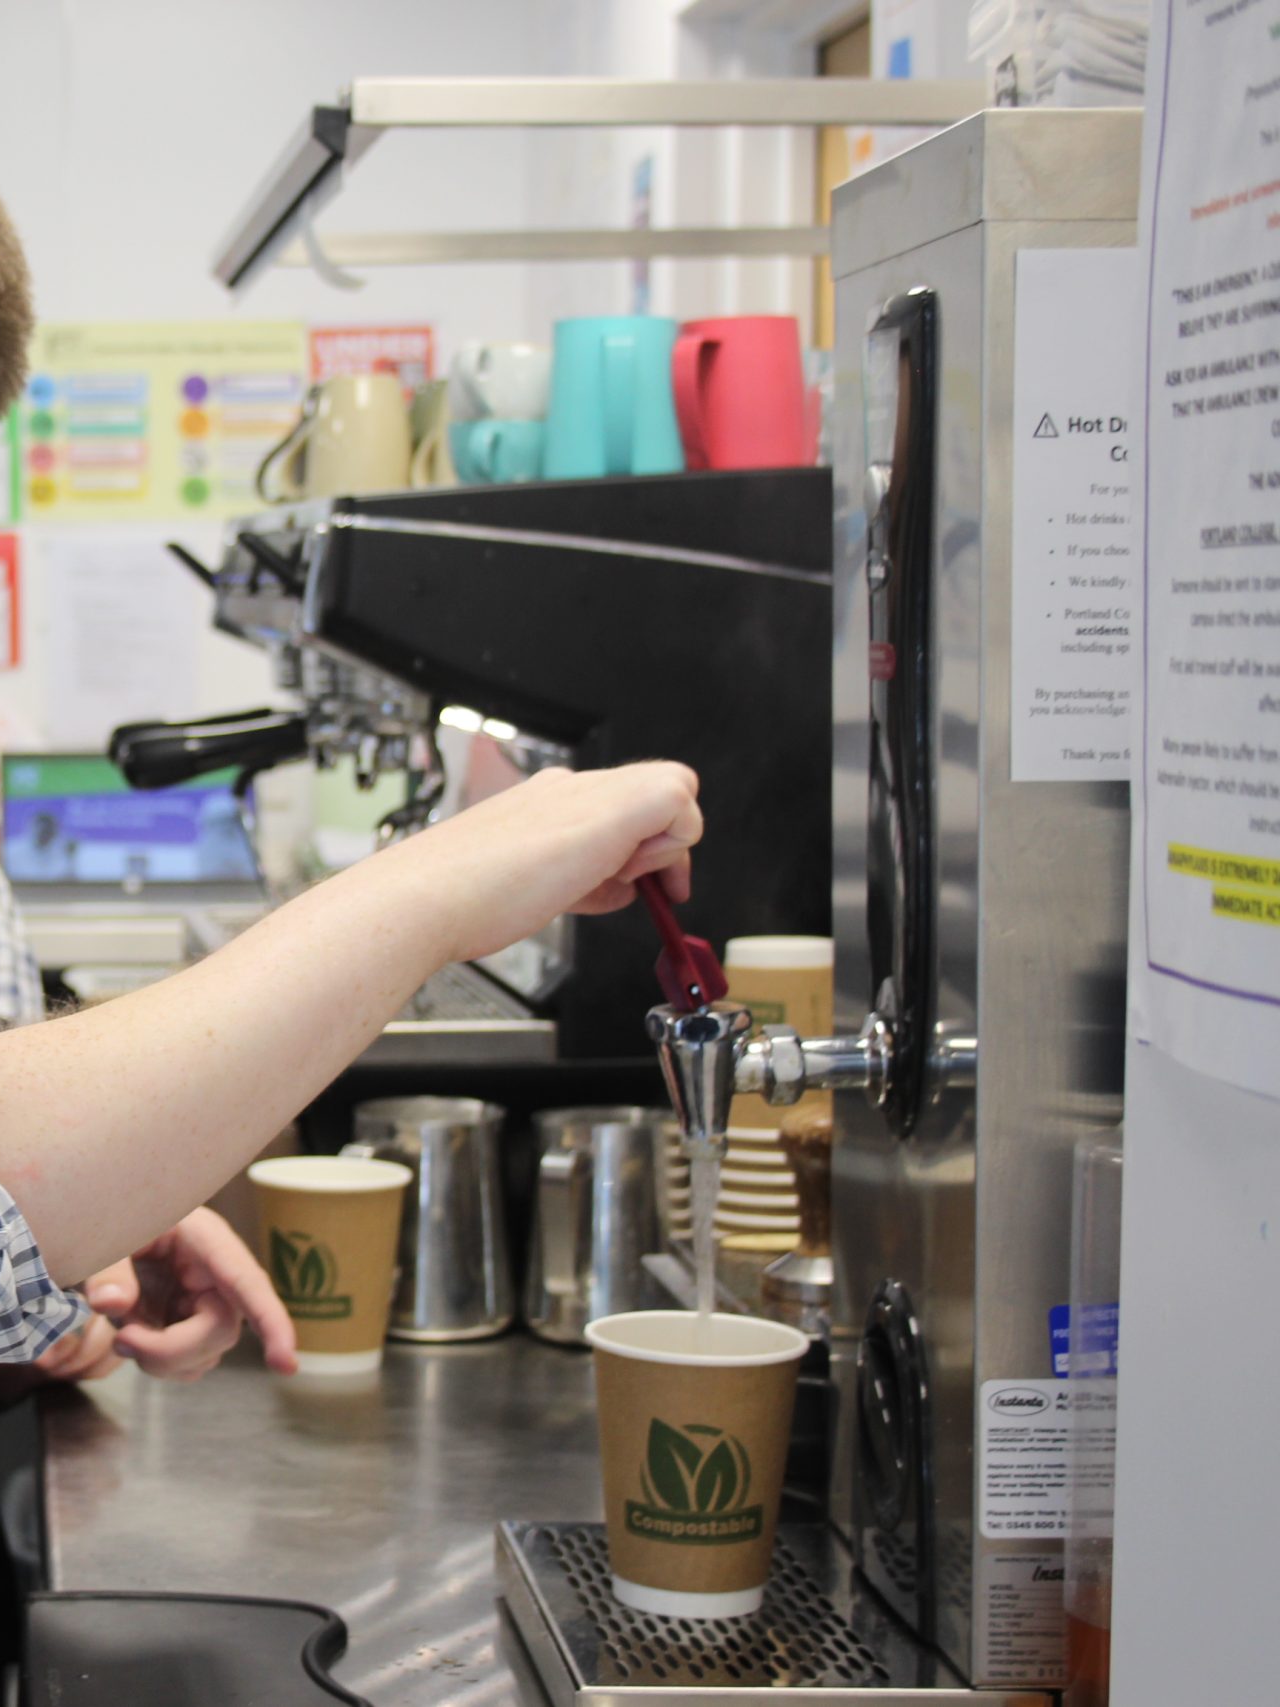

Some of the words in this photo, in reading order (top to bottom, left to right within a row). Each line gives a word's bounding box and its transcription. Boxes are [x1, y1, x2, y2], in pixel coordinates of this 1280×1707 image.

[1067, 416, 1104, 434] Hot
[1064, 607, 1112, 621] Portland
[1075, 625, 1129, 637] accidents
[1061, 747, 1096, 760] Thank
[631, 1510, 757, 1538] Compostable
